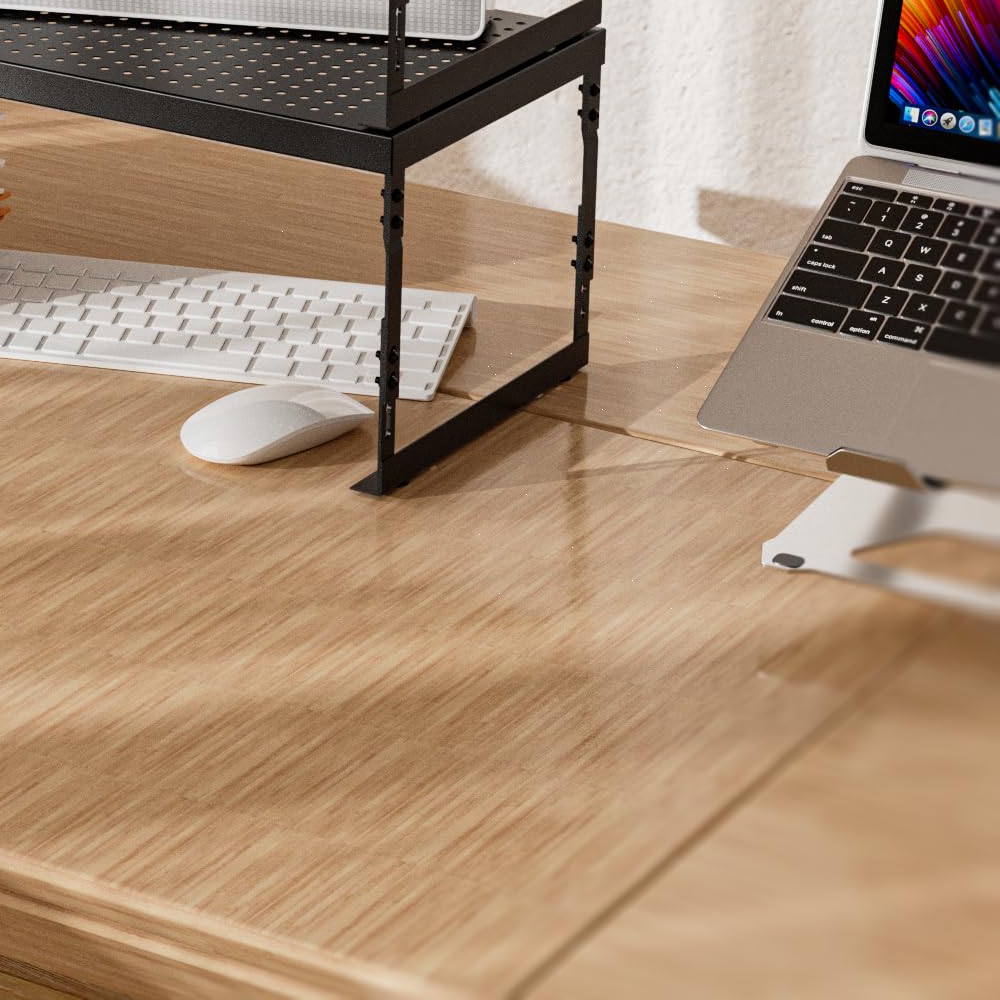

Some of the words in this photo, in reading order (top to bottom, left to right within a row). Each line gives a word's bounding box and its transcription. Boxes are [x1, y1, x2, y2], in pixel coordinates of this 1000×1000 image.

[915, 222, 923, 230] 2
[885, 240, 893, 248] Q
[920, 246, 931, 254] W
[807, 259, 822, 268] caps
[823, 262, 836, 270] lock
[878, 266, 886, 274] A
[915, 274, 924, 282] S
[791, 284, 807, 292] shift
[881, 296, 891, 304] Z
[918, 303, 928, 311] X
[811, 318, 834, 327] control
[850, 326, 870, 335] option
[884, 333, 918, 345] command
